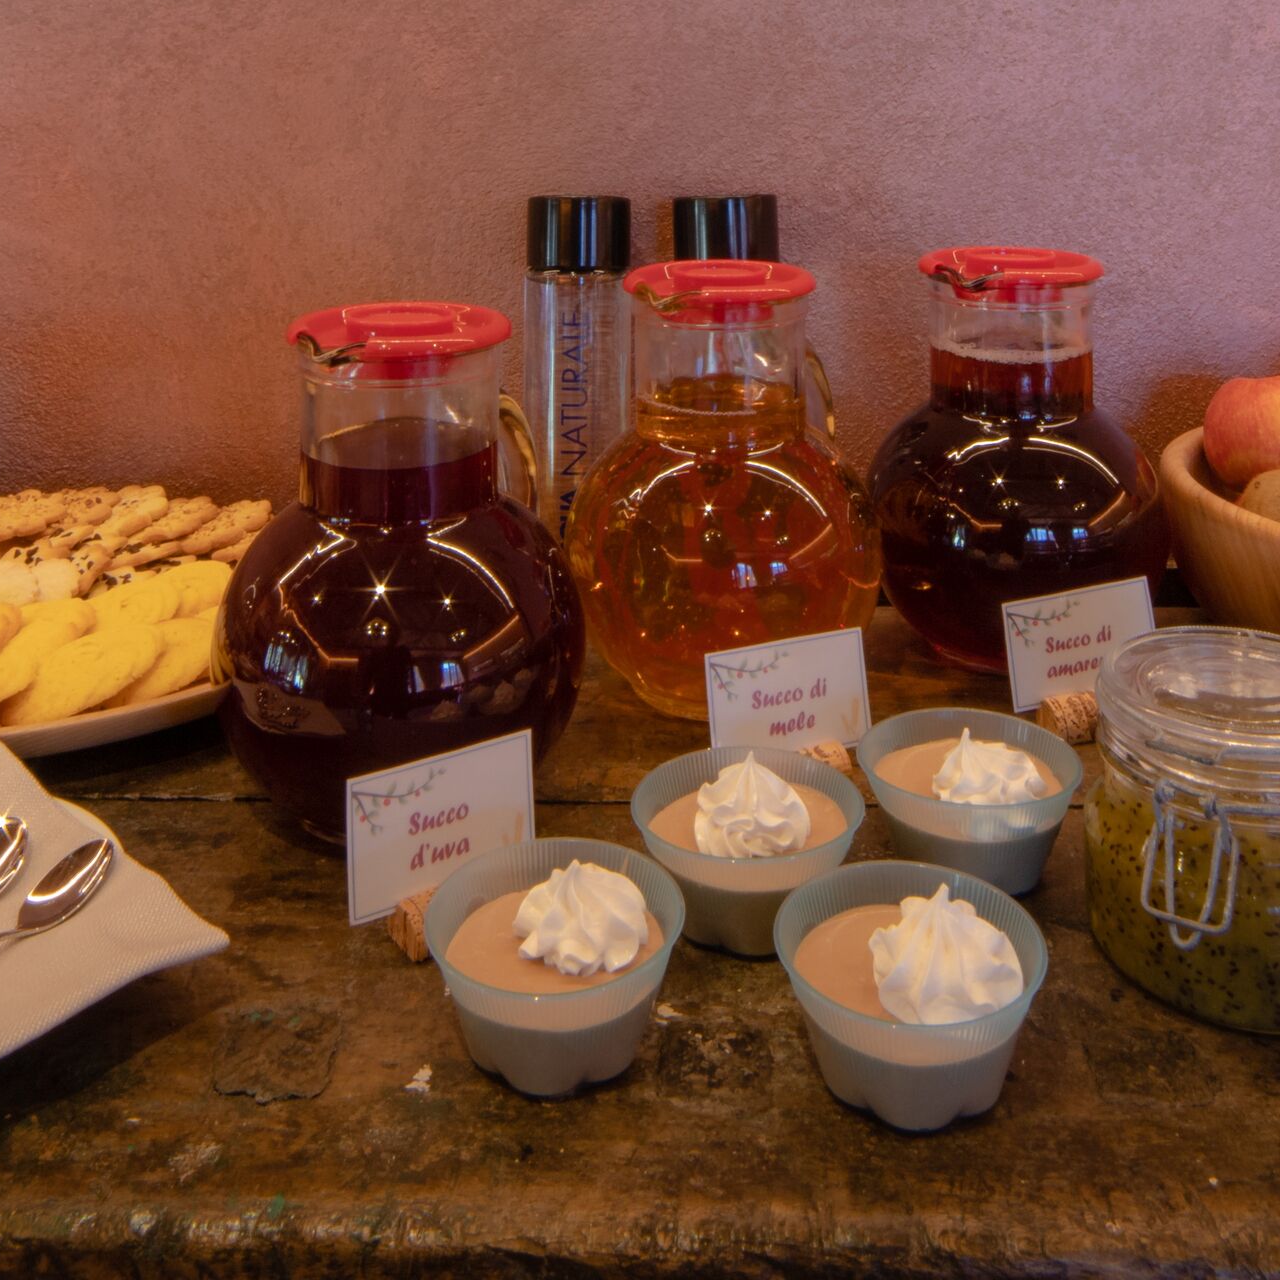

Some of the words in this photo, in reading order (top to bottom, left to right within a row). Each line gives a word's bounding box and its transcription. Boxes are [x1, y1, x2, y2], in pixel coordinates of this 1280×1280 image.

[1045, 634, 1091, 654] Succo
[1096, 625, 1112, 644] di
[751, 687, 804, 710] Succo
[809, 677, 827, 699] di
[769, 711, 816, 737] mele
[407, 802, 469, 836] Succo
[409, 837, 471, 871] d'uva
